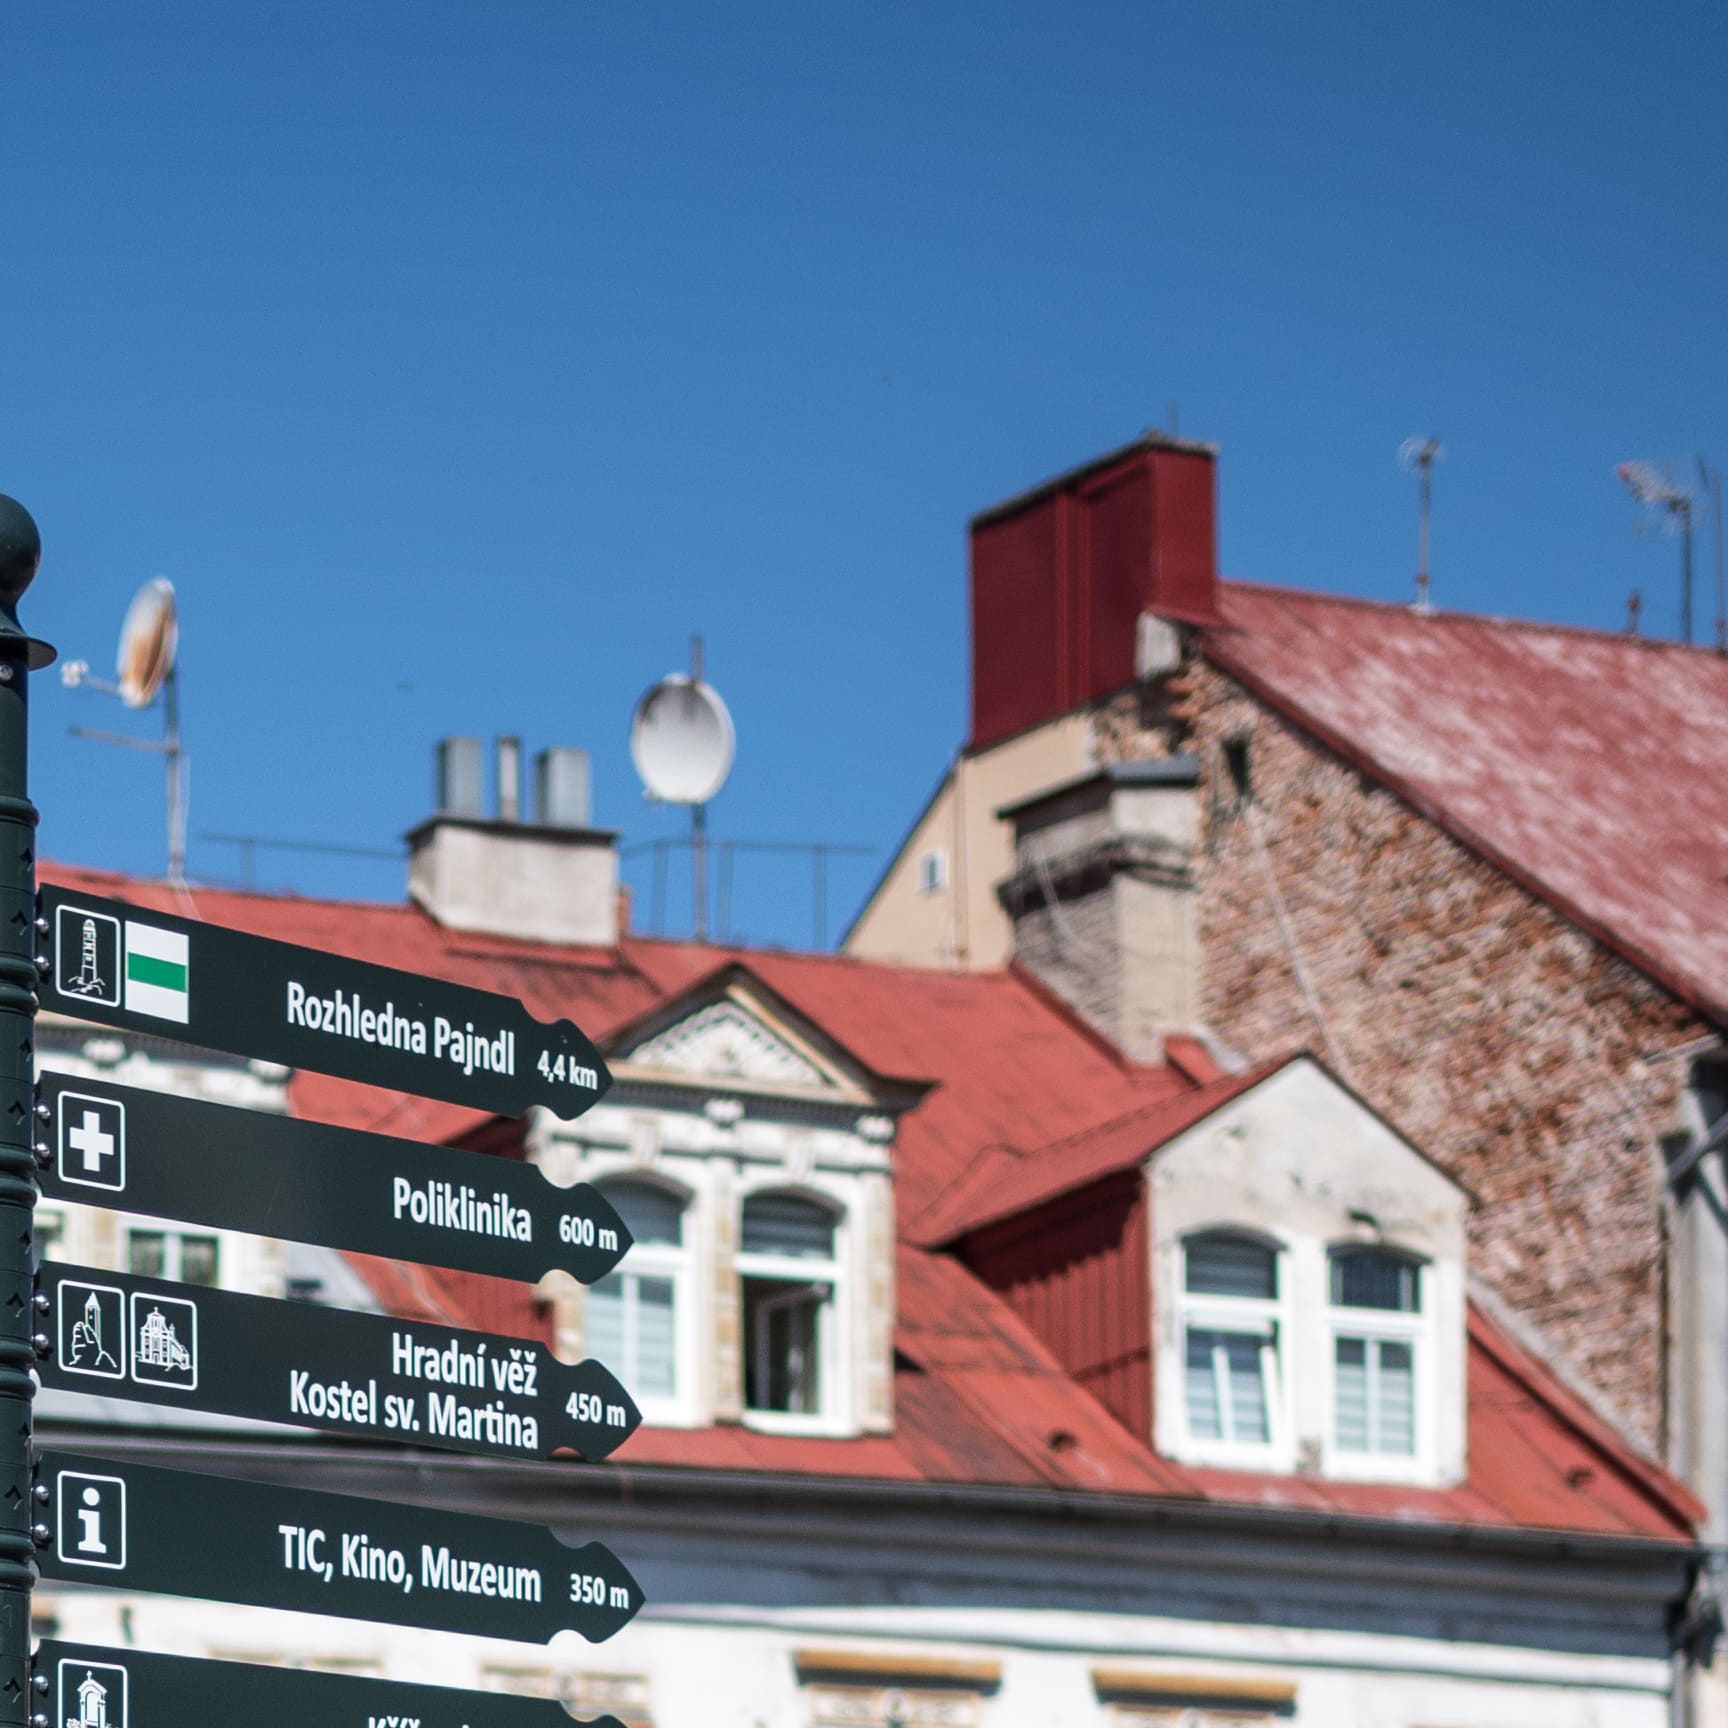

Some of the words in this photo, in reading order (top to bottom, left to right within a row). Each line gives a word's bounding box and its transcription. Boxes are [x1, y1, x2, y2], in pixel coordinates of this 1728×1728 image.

[287, 981, 427, 1055] Rozhledna
[434, 1016, 515, 1076] Pajndl
[537, 1049, 566, 1083] 4,4
[570, 1055, 598, 1090] km
[393, 1176, 532, 1242] Poliklinika
[559, 1214, 595, 1247] 600
[598, 1228, 618, 1252] m
[392, 1332, 487, 1388] Hradní
[490, 1348, 538, 1397] věž
[290, 1369, 377, 1425] Kostel
[384, 1393, 420, 1433] sv.
[428, 1392, 538, 1450] Martina
[565, 1391, 603, 1424] 450
[606, 1404, 626, 1428] m
[278, 1524, 334, 1583] TIC,
[342, 1533, 413, 1594] Kino,
[421, 1544, 541, 1603] Muzeum
[570, 1573, 606, 1606] 350
[609, 1586, 629, 1609] m
